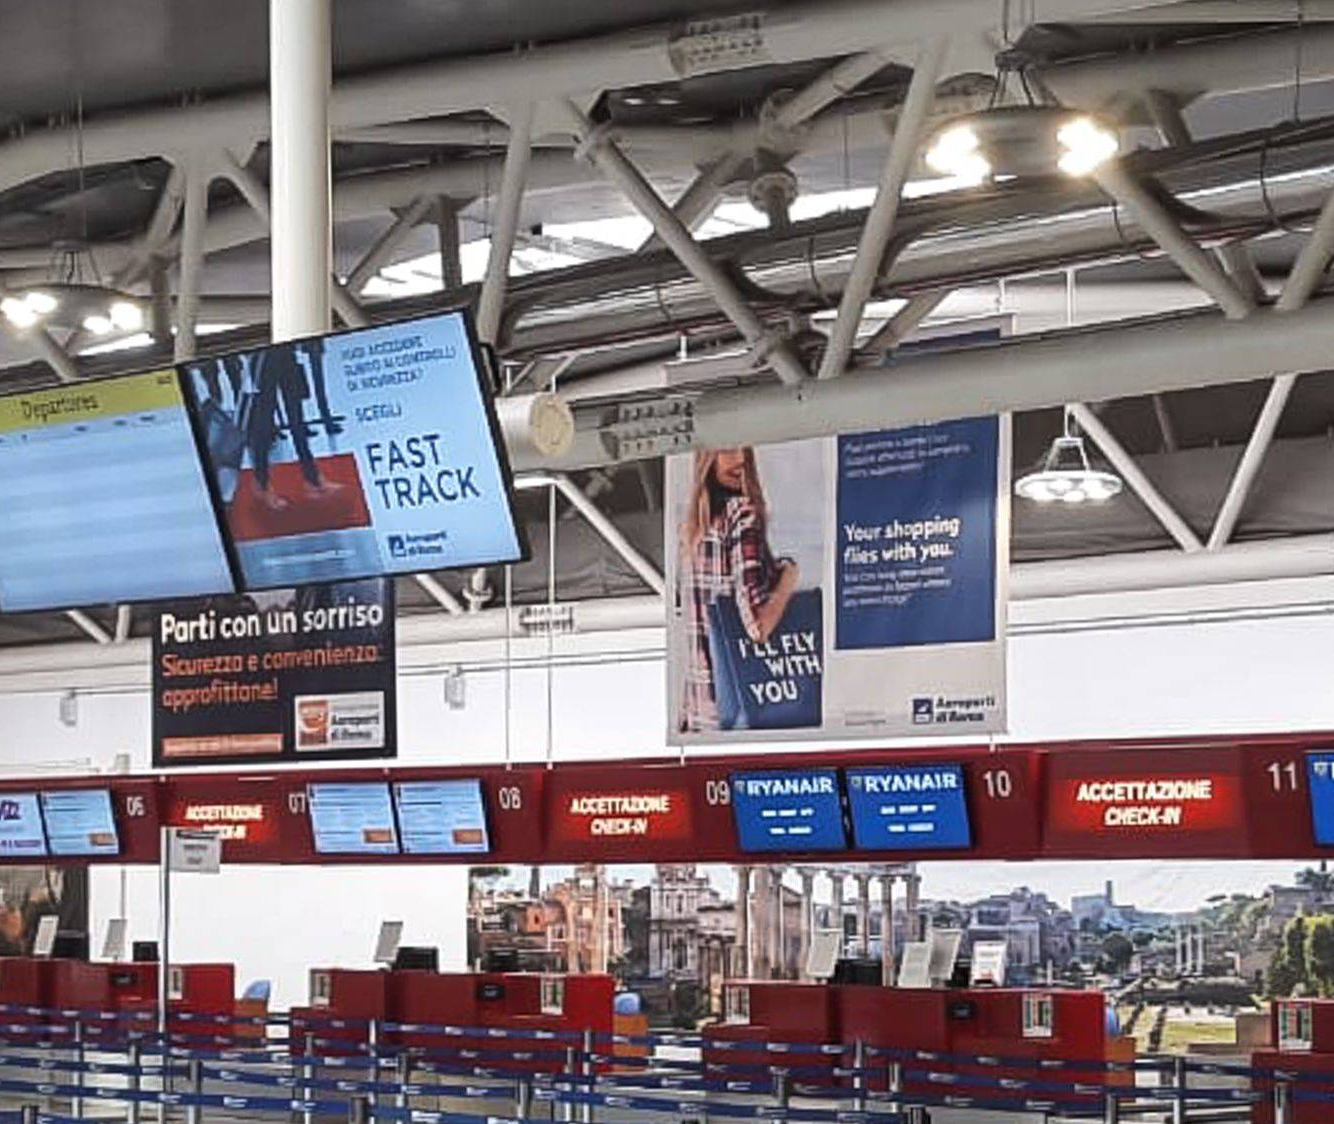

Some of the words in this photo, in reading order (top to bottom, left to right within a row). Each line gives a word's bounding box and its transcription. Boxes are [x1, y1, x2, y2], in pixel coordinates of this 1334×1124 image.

[365, 434, 441, 475] FAST
[374, 466, 481, 509] TRACK
[844, 522, 882, 541] Your
[884, 514, 960, 541] shopping
[844, 546, 878, 565] flies
[881, 541, 916, 562] with
[161, 610, 216, 645] Parti
[220, 613, 262, 639] con
[267, 610, 297, 634] un
[302, 596, 384, 634] sorriso
[783, 631, 816, 656] FLY
[161, 653, 244, 677] Sicurezza
[247, 655, 259, 673] e
[767, 651, 823, 679] WITH
[161, 677, 279, 713] approfittane!
[750, 679, 798, 706] YOU
[746, 776, 834, 796] RYANAIR
[865, 772, 959, 792] RYANAIR
[982, 769, 1012, 798] 10
[1267, 761, 1298, 791] 11
[705, 780, 731, 805] 09
[1076, 779, 1213, 802] ACCETTAZIONE
[569, 794, 671, 815] ACCETTAZIONE
[1103, 806, 1183, 827] CHECK-IN
